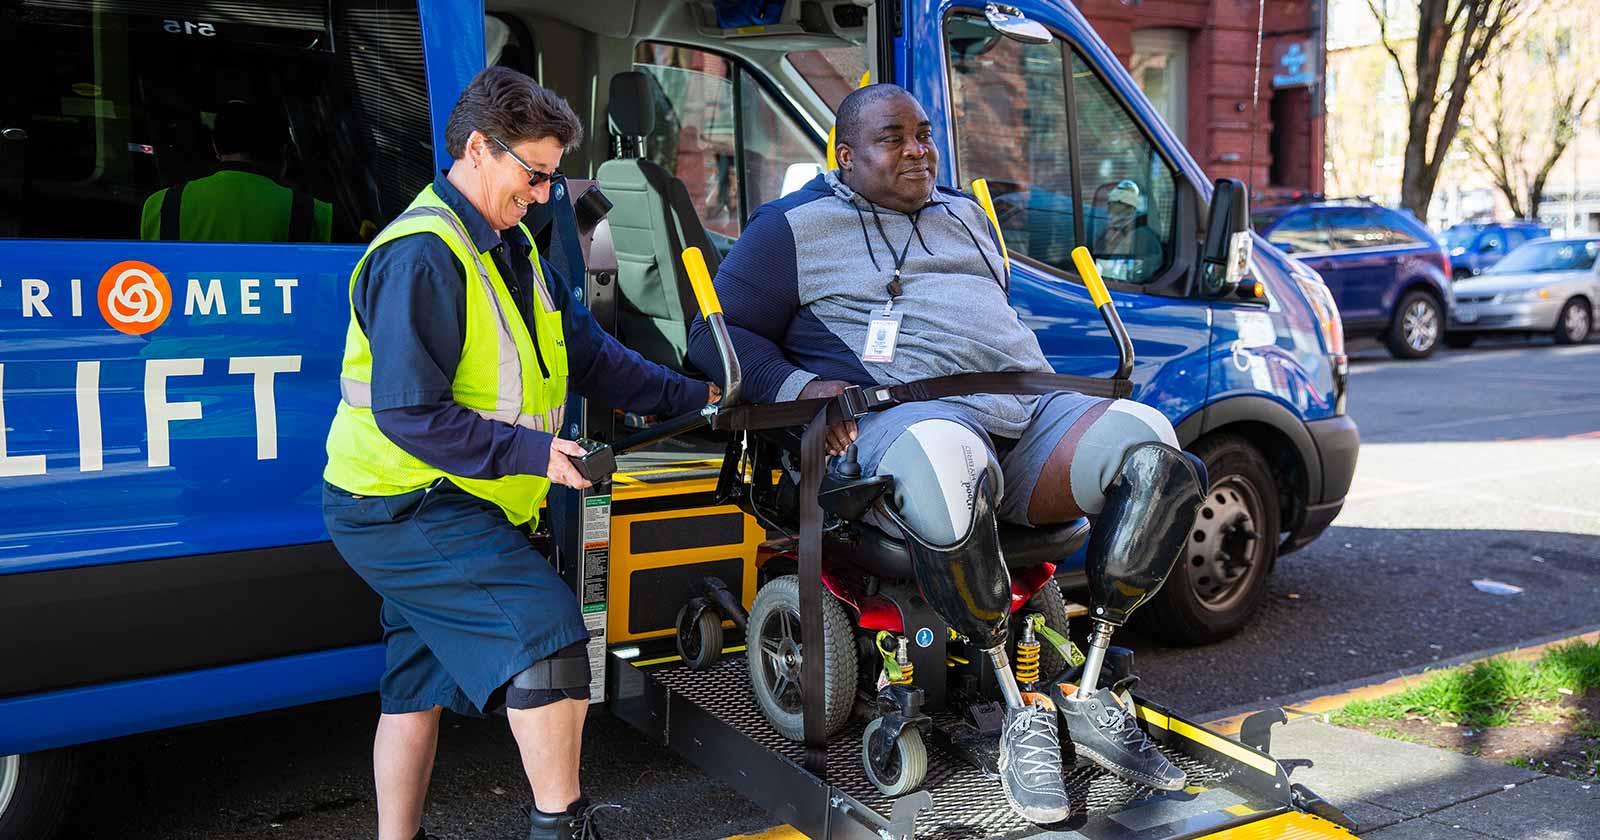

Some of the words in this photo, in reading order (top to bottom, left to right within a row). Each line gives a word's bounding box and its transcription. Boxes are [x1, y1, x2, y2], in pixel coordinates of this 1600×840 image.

[0, 278, 83, 318] RI
[184, 278, 299, 316] MET
[0, 355, 302, 477] LIFT
